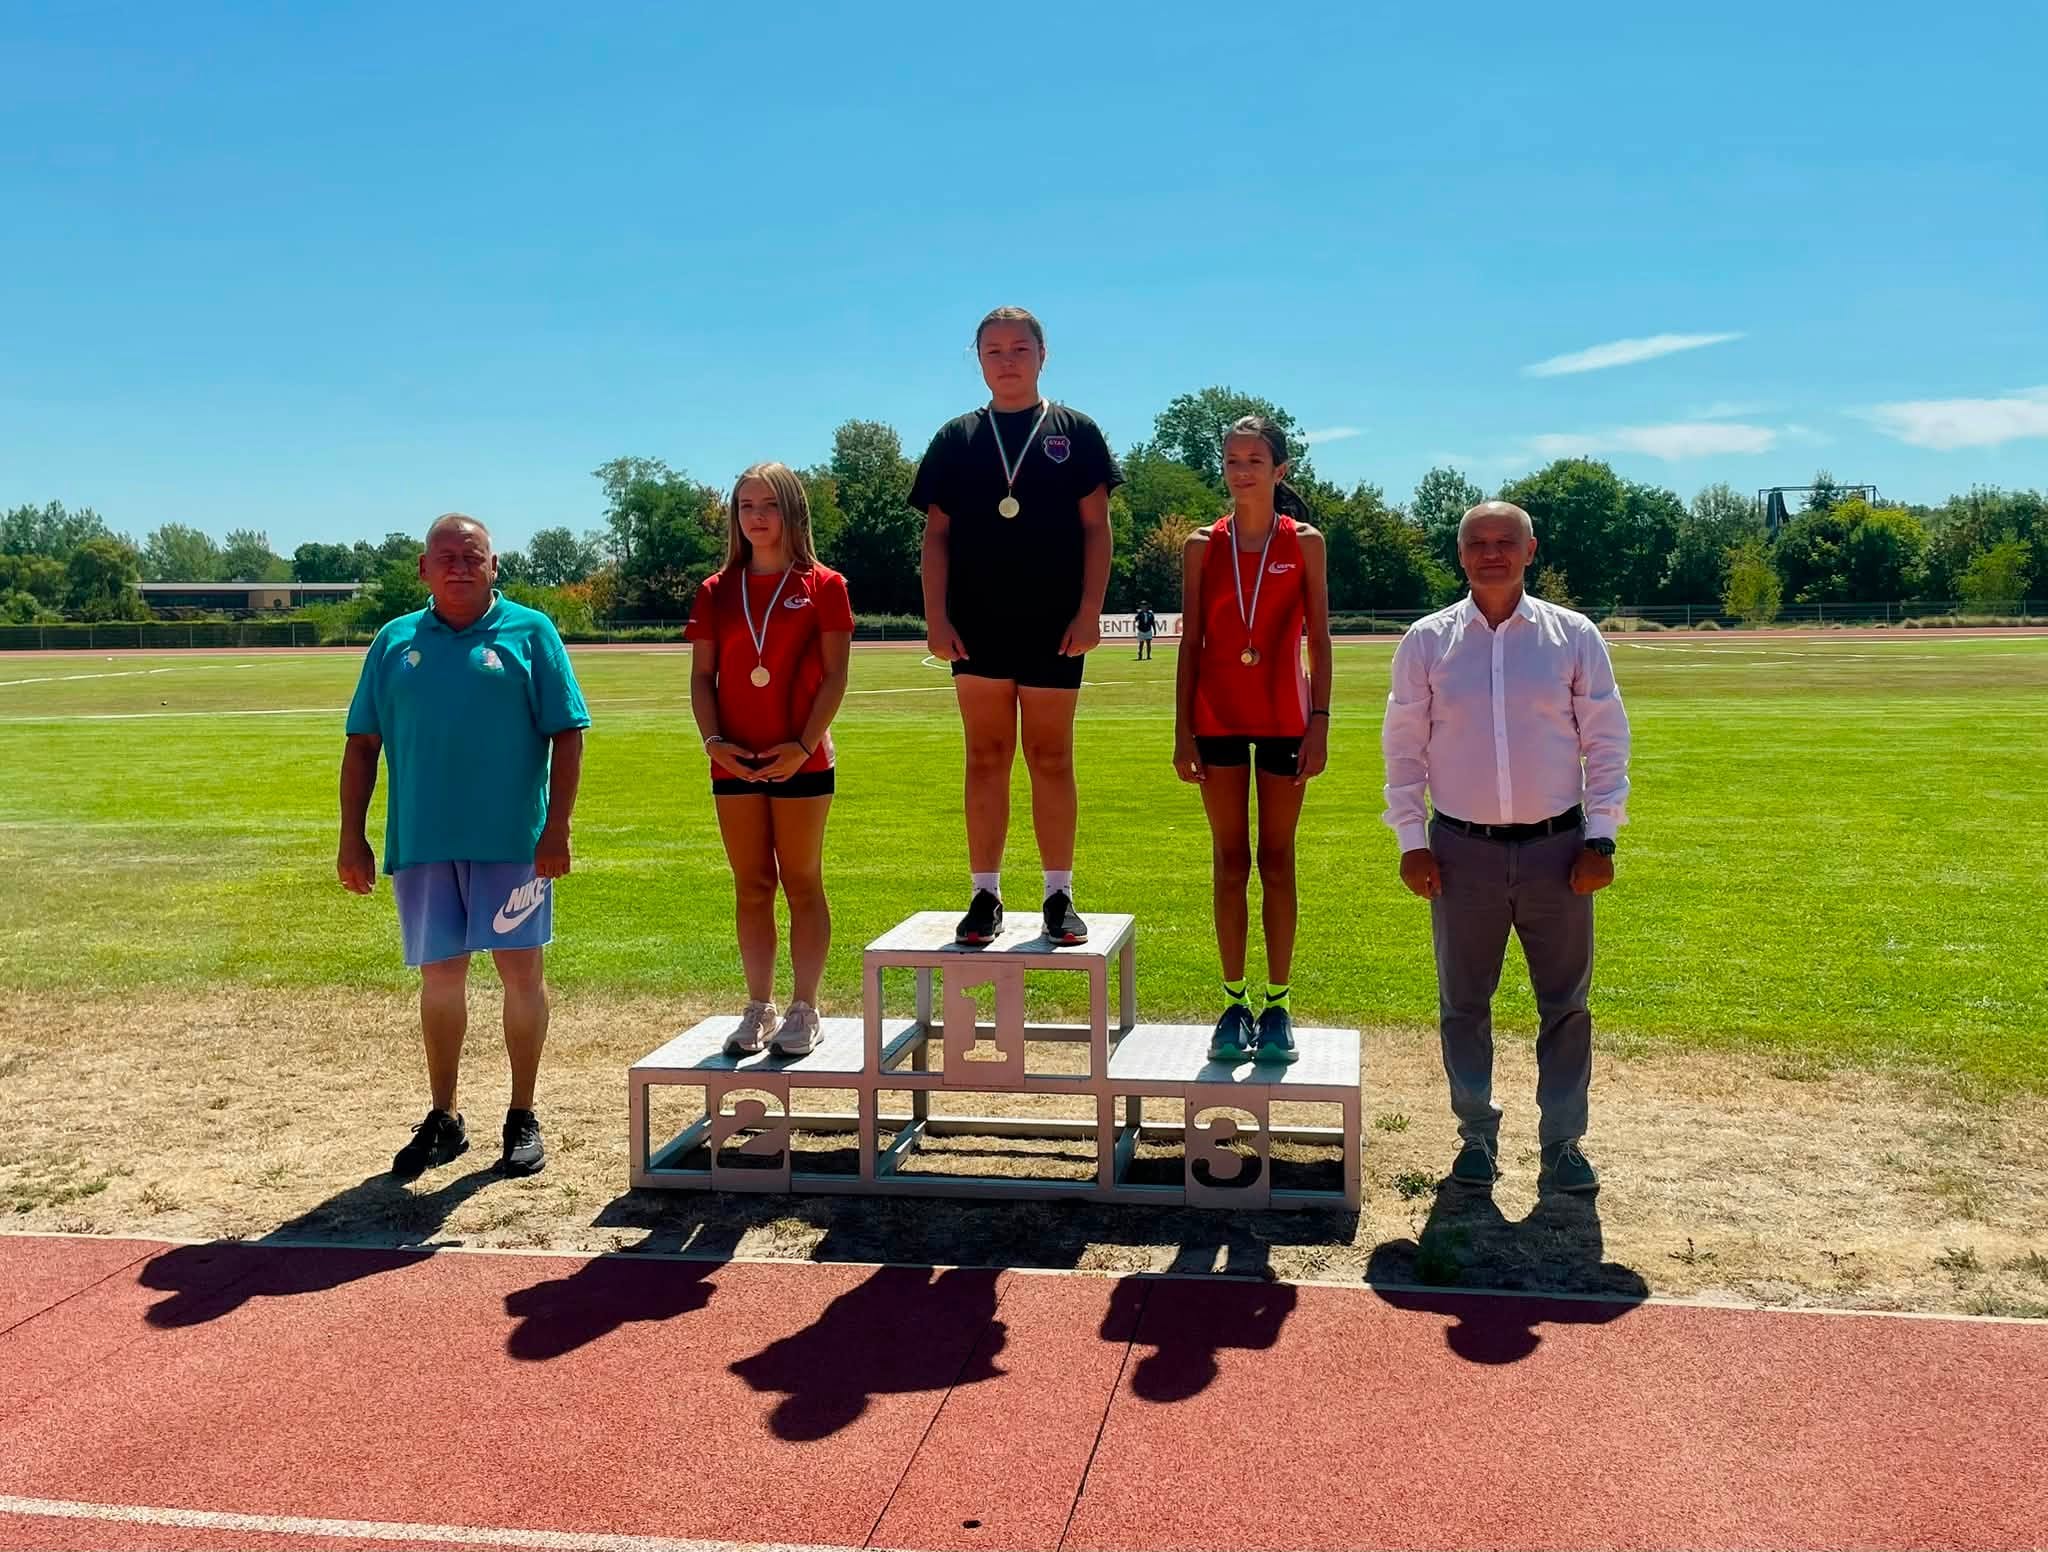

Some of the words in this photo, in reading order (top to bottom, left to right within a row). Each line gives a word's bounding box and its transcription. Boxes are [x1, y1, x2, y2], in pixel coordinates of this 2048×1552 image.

[960, 980, 1008, 1063] 1
[717, 1088, 785, 1169] 2
[1191, 1106, 1263, 1188] 3
